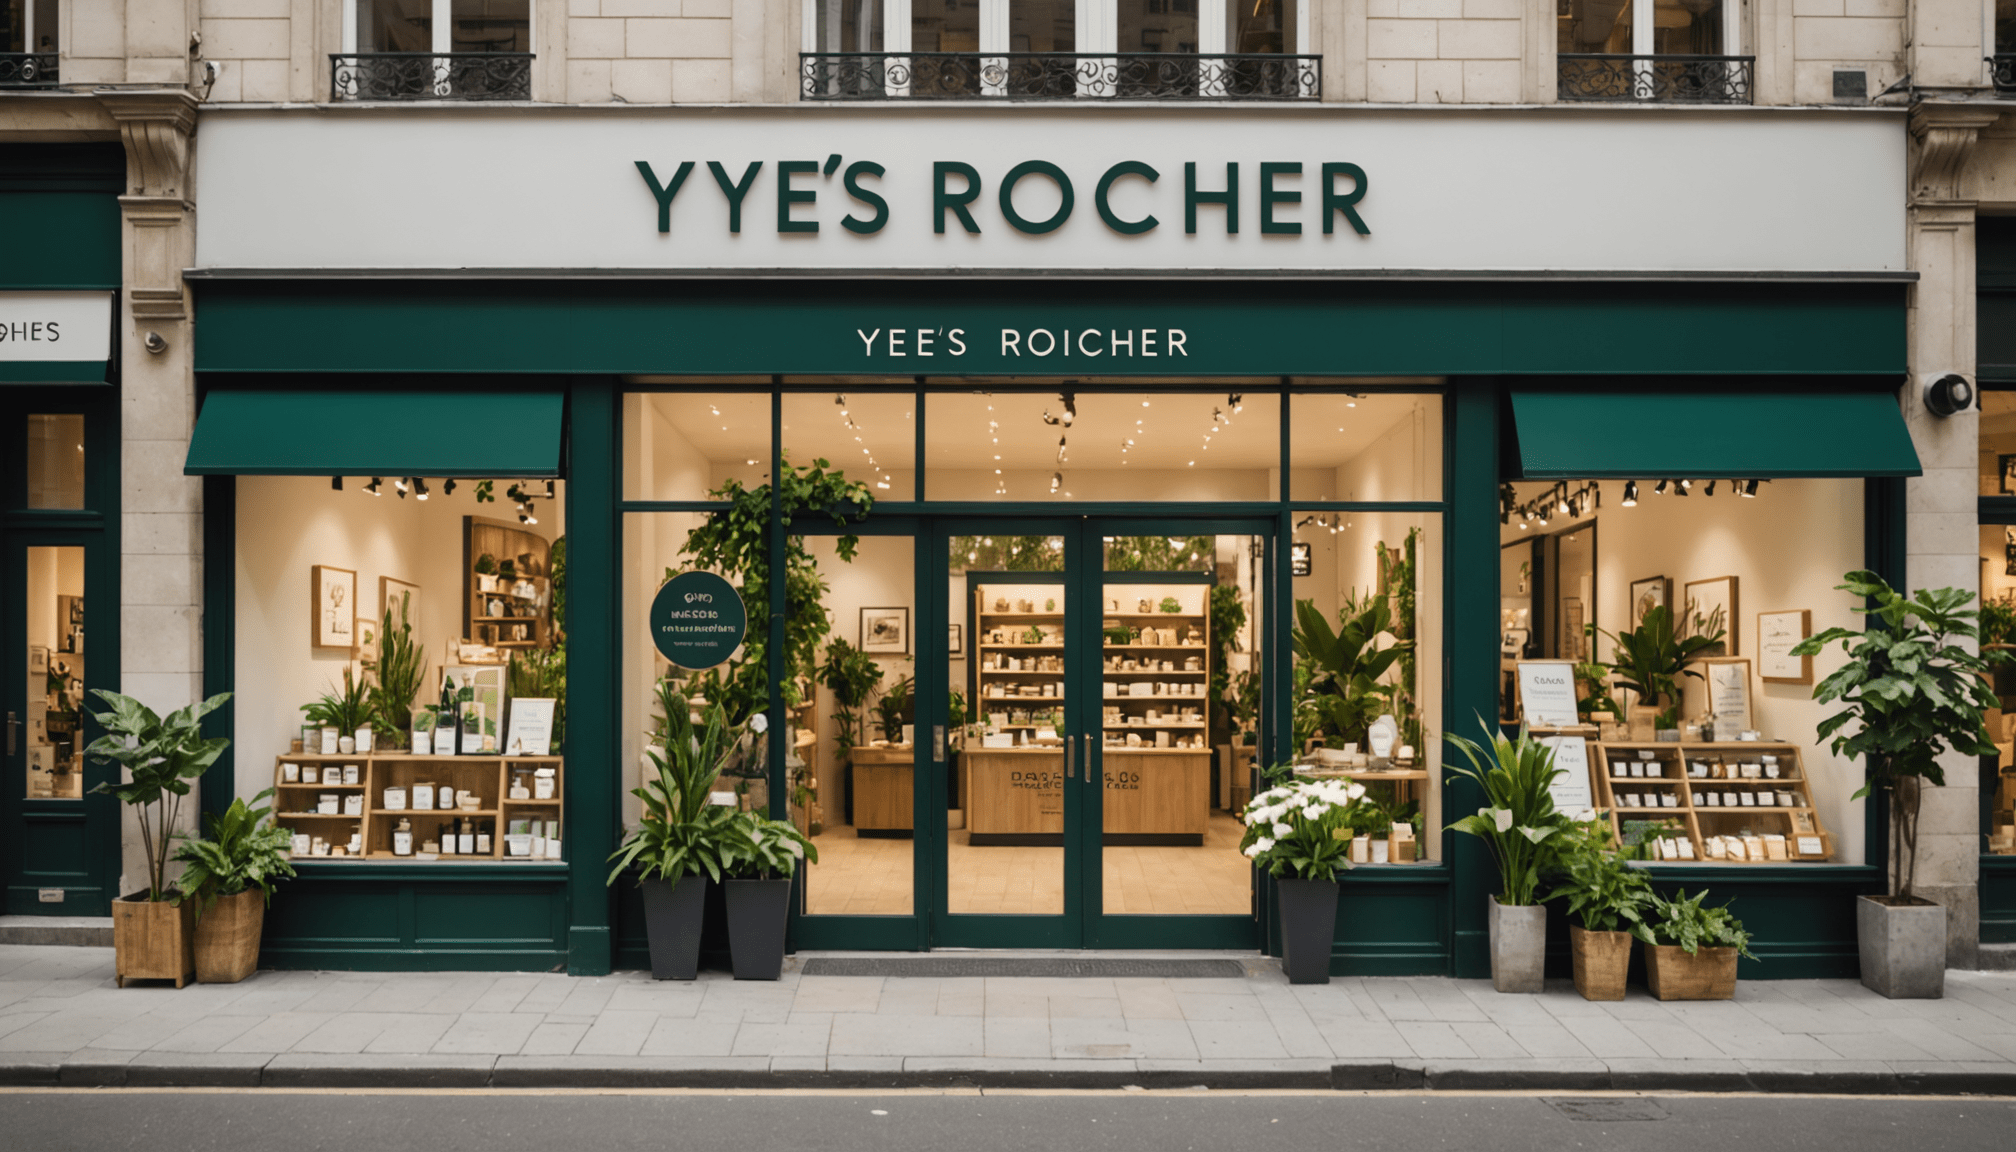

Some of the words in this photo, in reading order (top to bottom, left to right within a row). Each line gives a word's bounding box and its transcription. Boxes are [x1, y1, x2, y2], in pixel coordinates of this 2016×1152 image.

[634, 153, 890, 235] YYE'S
[932, 159, 1372, 236] ROCHER
[857, 327, 967, 357] YEE'S
[1001, 328, 1189, 357] ROICHER
